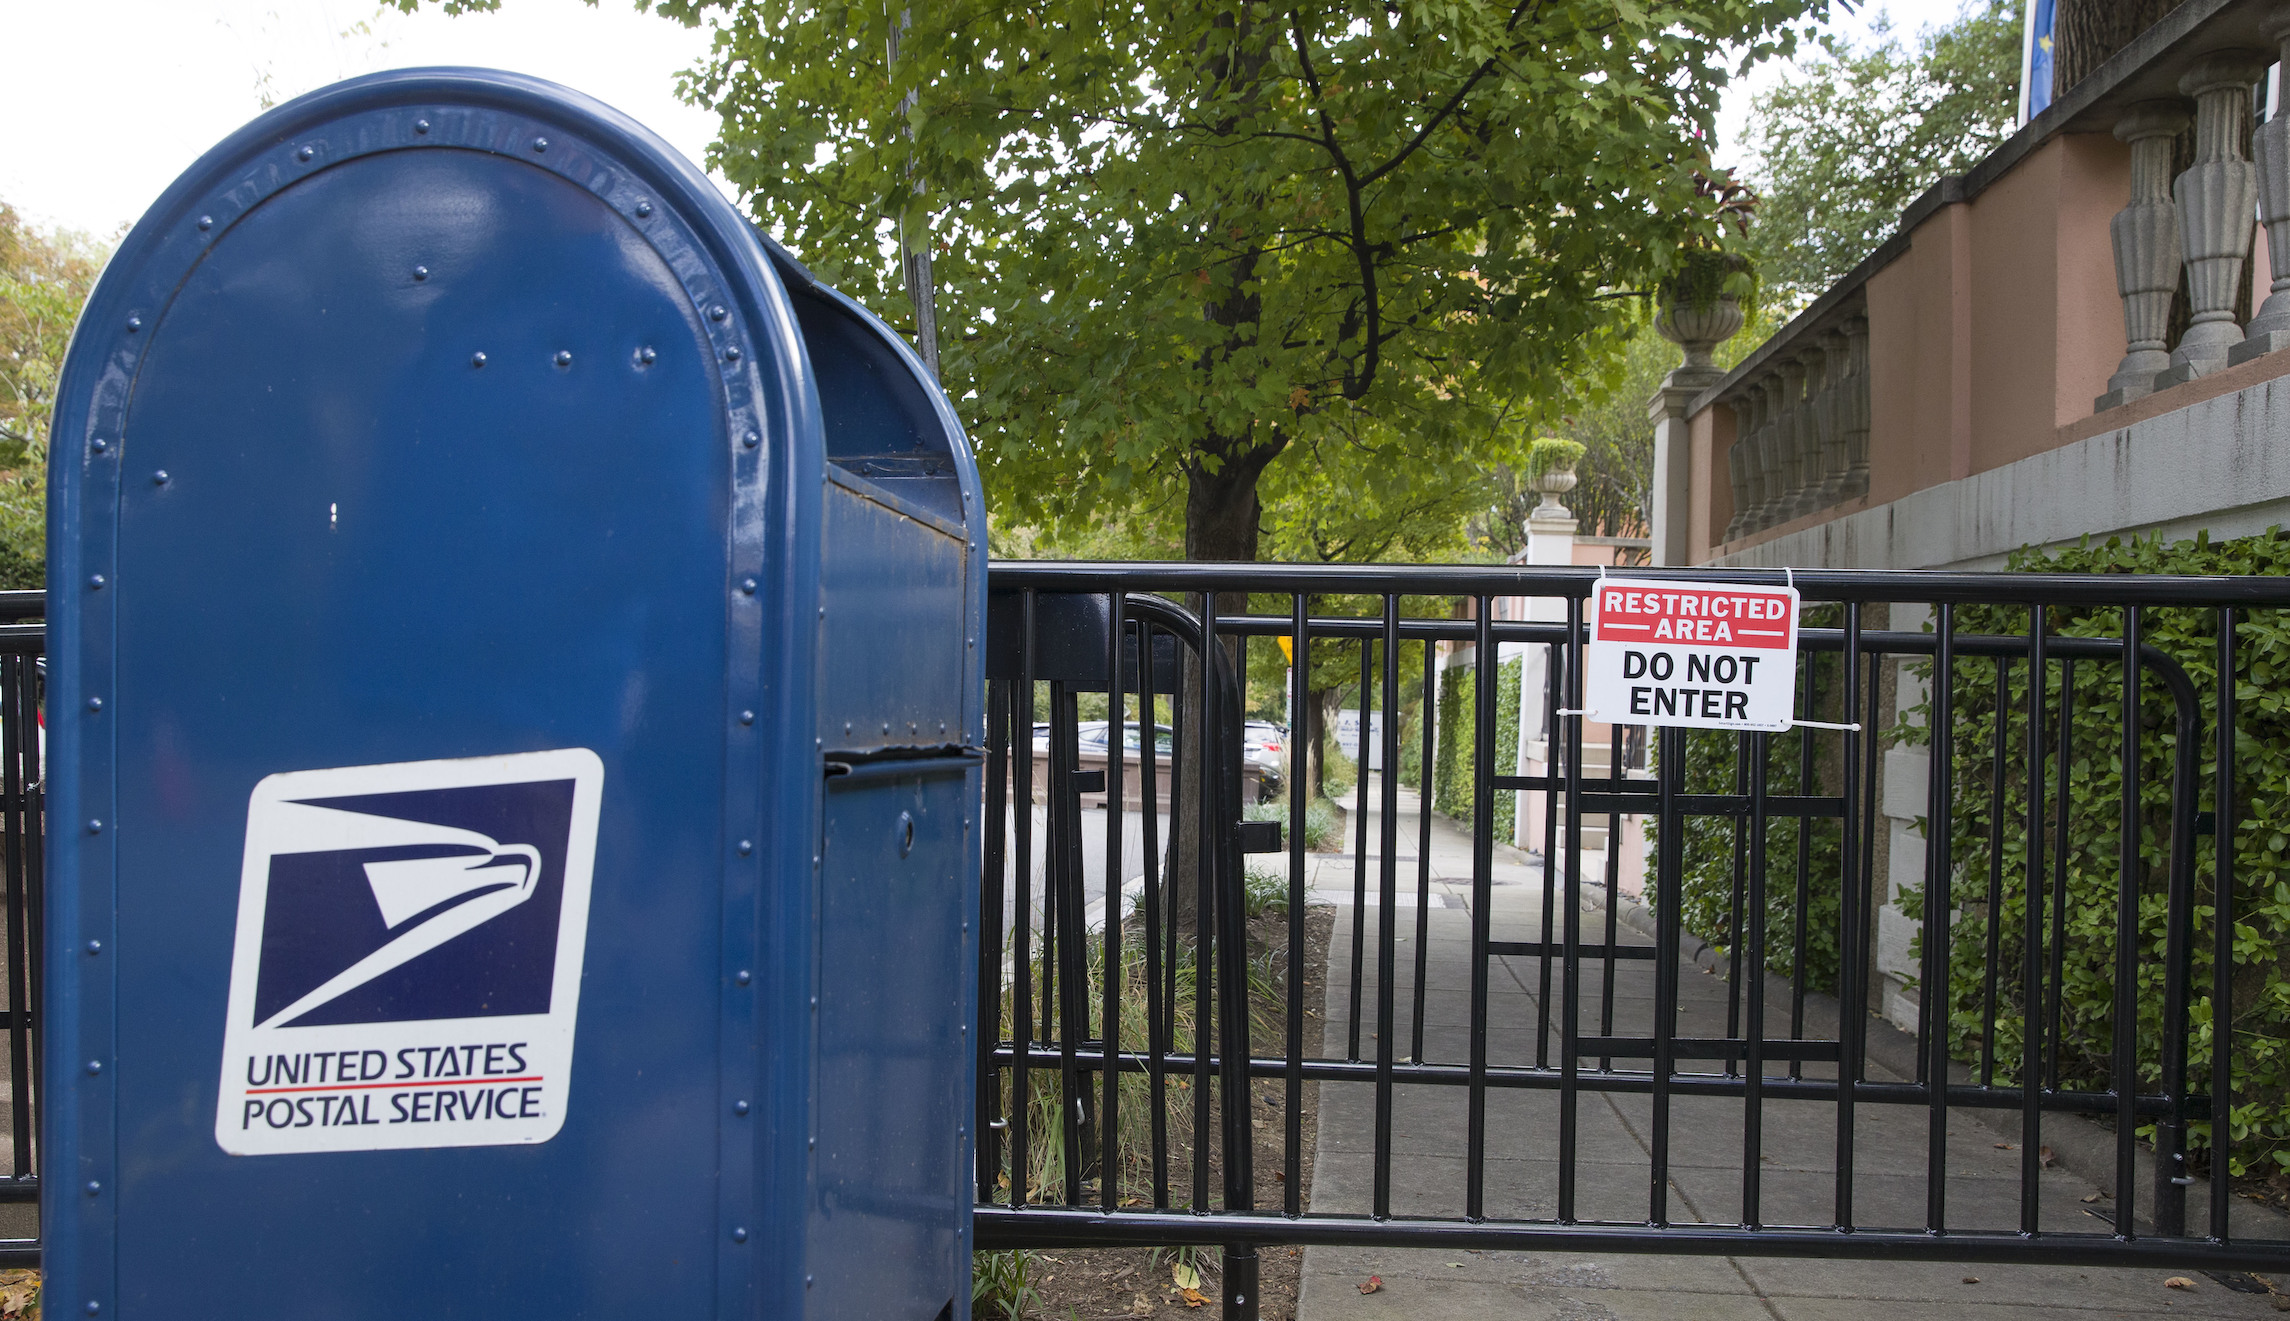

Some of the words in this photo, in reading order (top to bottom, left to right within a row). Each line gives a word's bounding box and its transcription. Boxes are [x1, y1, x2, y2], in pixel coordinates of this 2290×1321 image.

[1604, 592, 1786, 620] RESTRICTED
[1654, 618, 1733, 642] AREA
[1623, 650, 1674, 681] DO
[1687, 653, 1760, 685] NOT
[1630, 686, 1749, 720] ENTER
[246, 1050, 387, 1086] UNITED
[395, 1042, 527, 1079] STATES
[242, 1094, 380, 1130] POSTAL
[389, 1087, 543, 1124] SERVICE
